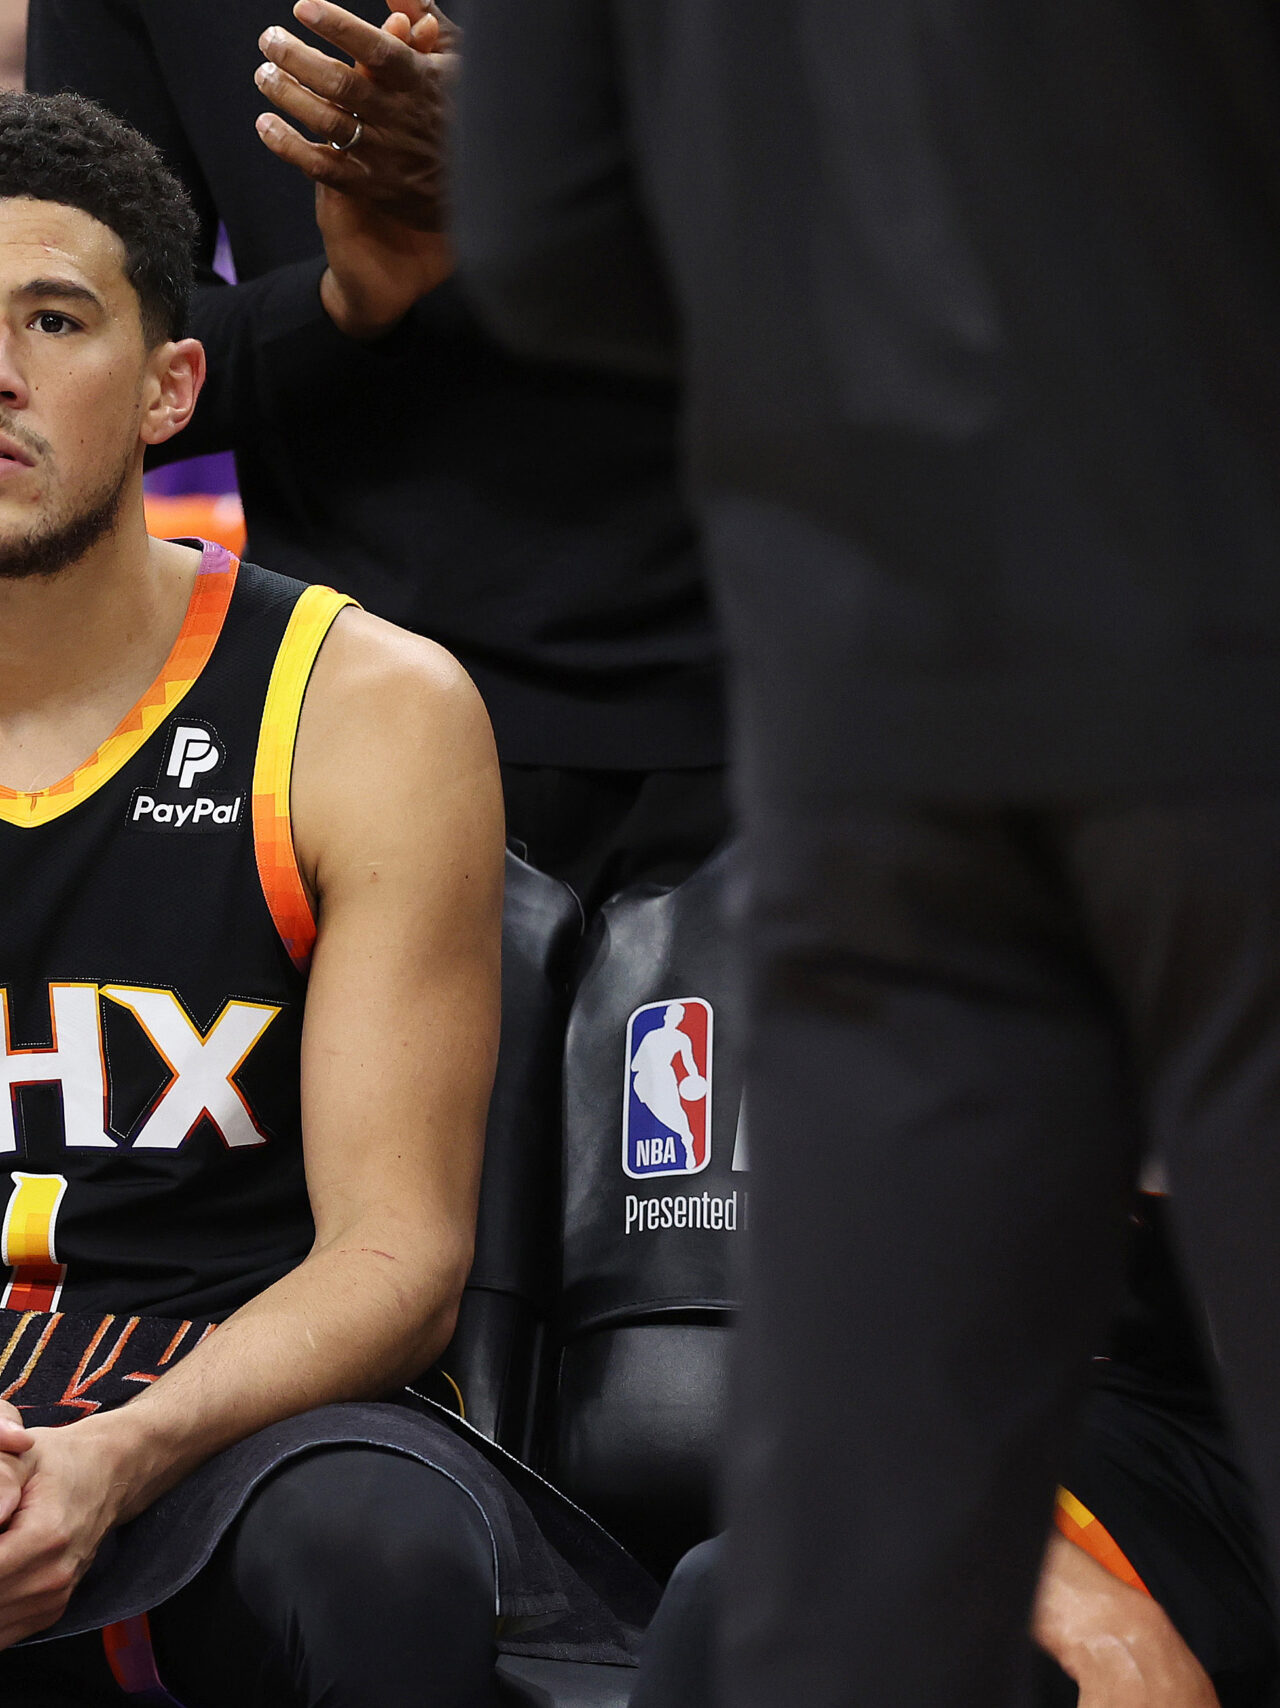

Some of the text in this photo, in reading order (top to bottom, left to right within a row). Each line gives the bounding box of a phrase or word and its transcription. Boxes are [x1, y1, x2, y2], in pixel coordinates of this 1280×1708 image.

[132, 795, 241, 828] PayPal
[635, 1136, 677, 1168] NBA
[625, 1190, 738, 1235] Presented
[0, 1170, 68, 1312] 1
